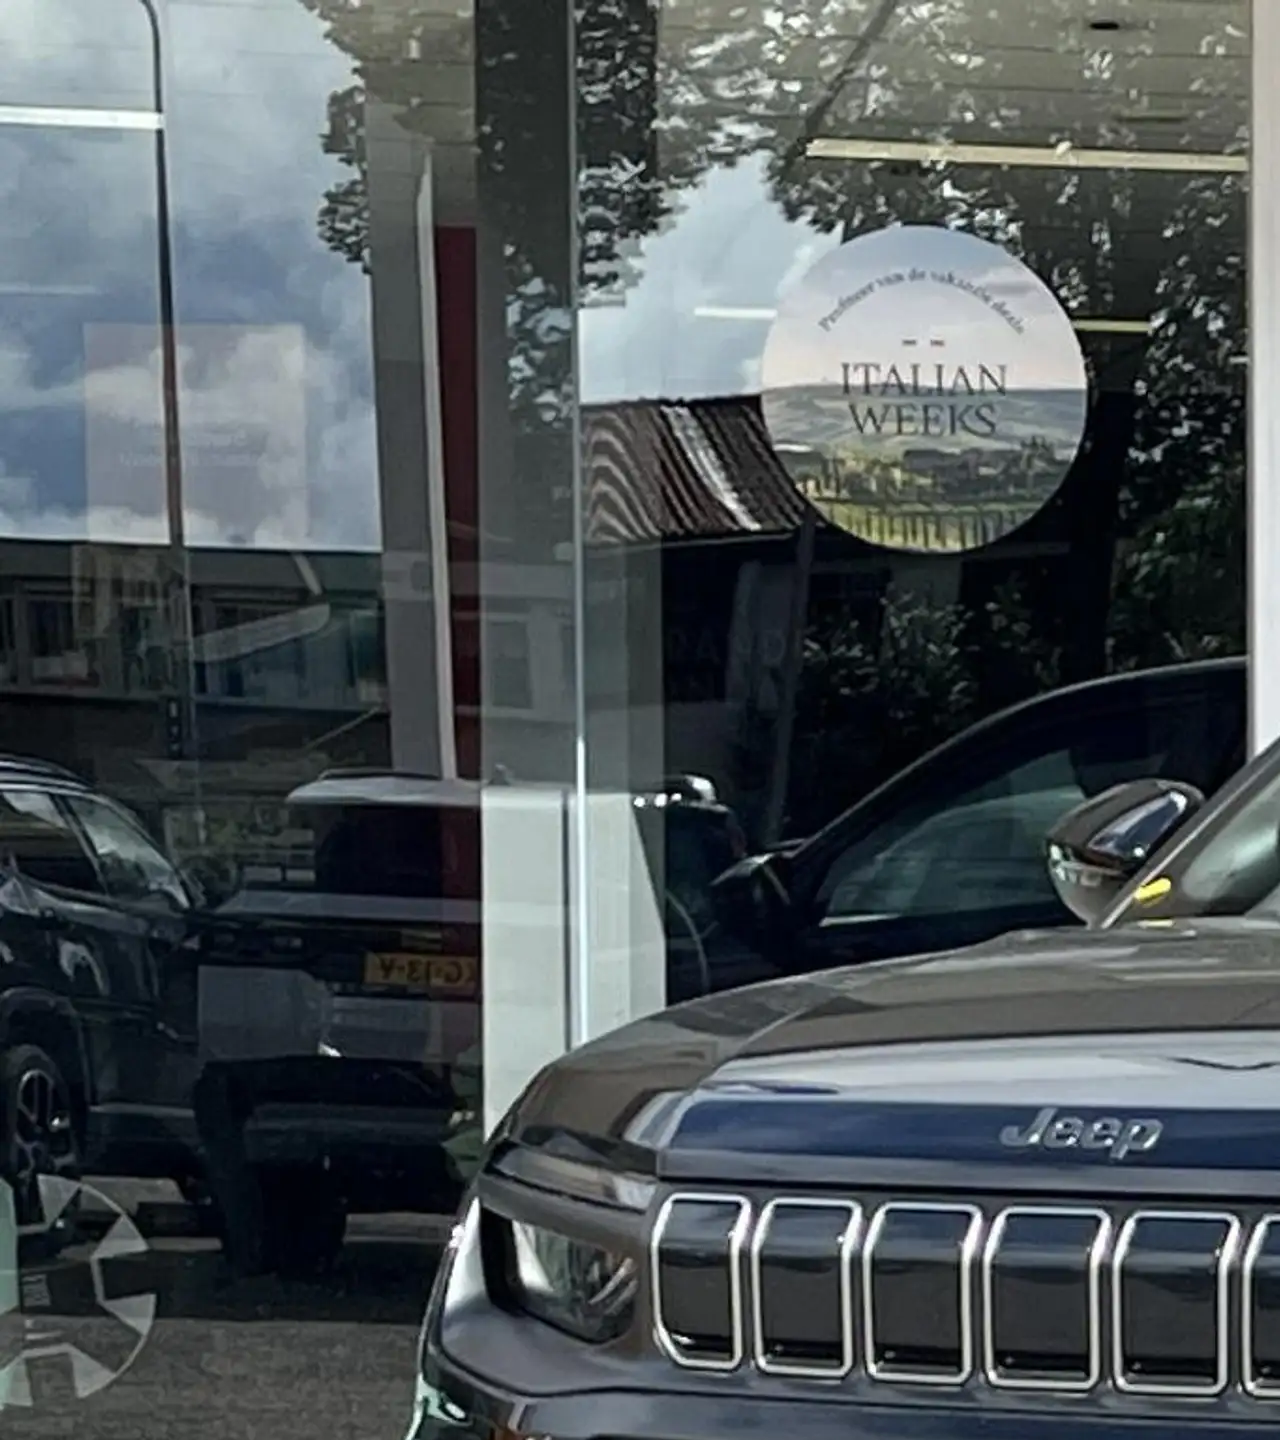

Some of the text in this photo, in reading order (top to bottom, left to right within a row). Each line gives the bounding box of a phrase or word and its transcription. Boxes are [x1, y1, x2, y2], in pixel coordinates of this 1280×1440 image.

[840, 361, 1008, 397] ITALIAN
[848, 403, 998, 436] WEEKS
[1000, 1107, 1163, 1161] Jeep
